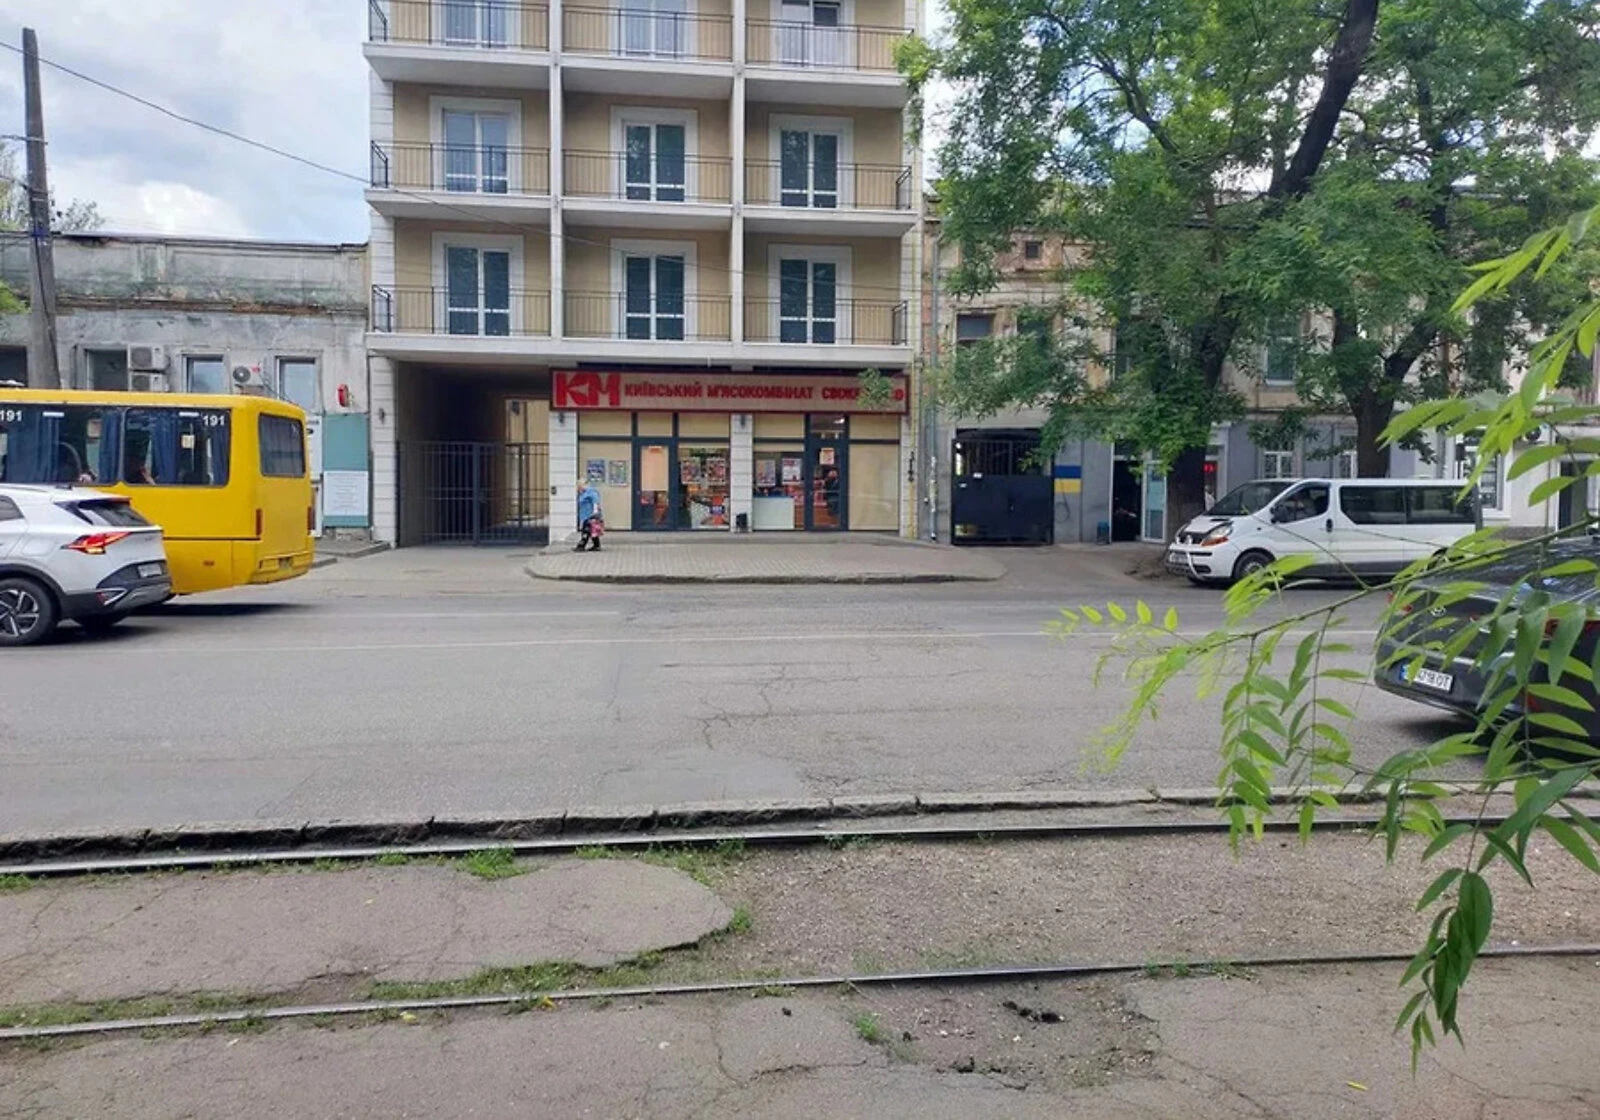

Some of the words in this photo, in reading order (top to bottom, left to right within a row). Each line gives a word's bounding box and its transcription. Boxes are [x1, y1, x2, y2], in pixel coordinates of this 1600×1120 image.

[625, 380, 703, 397] КИЇВСЬКИЙ
[0, 410, 23, 422] 191
[203, 415, 225, 427] 191
